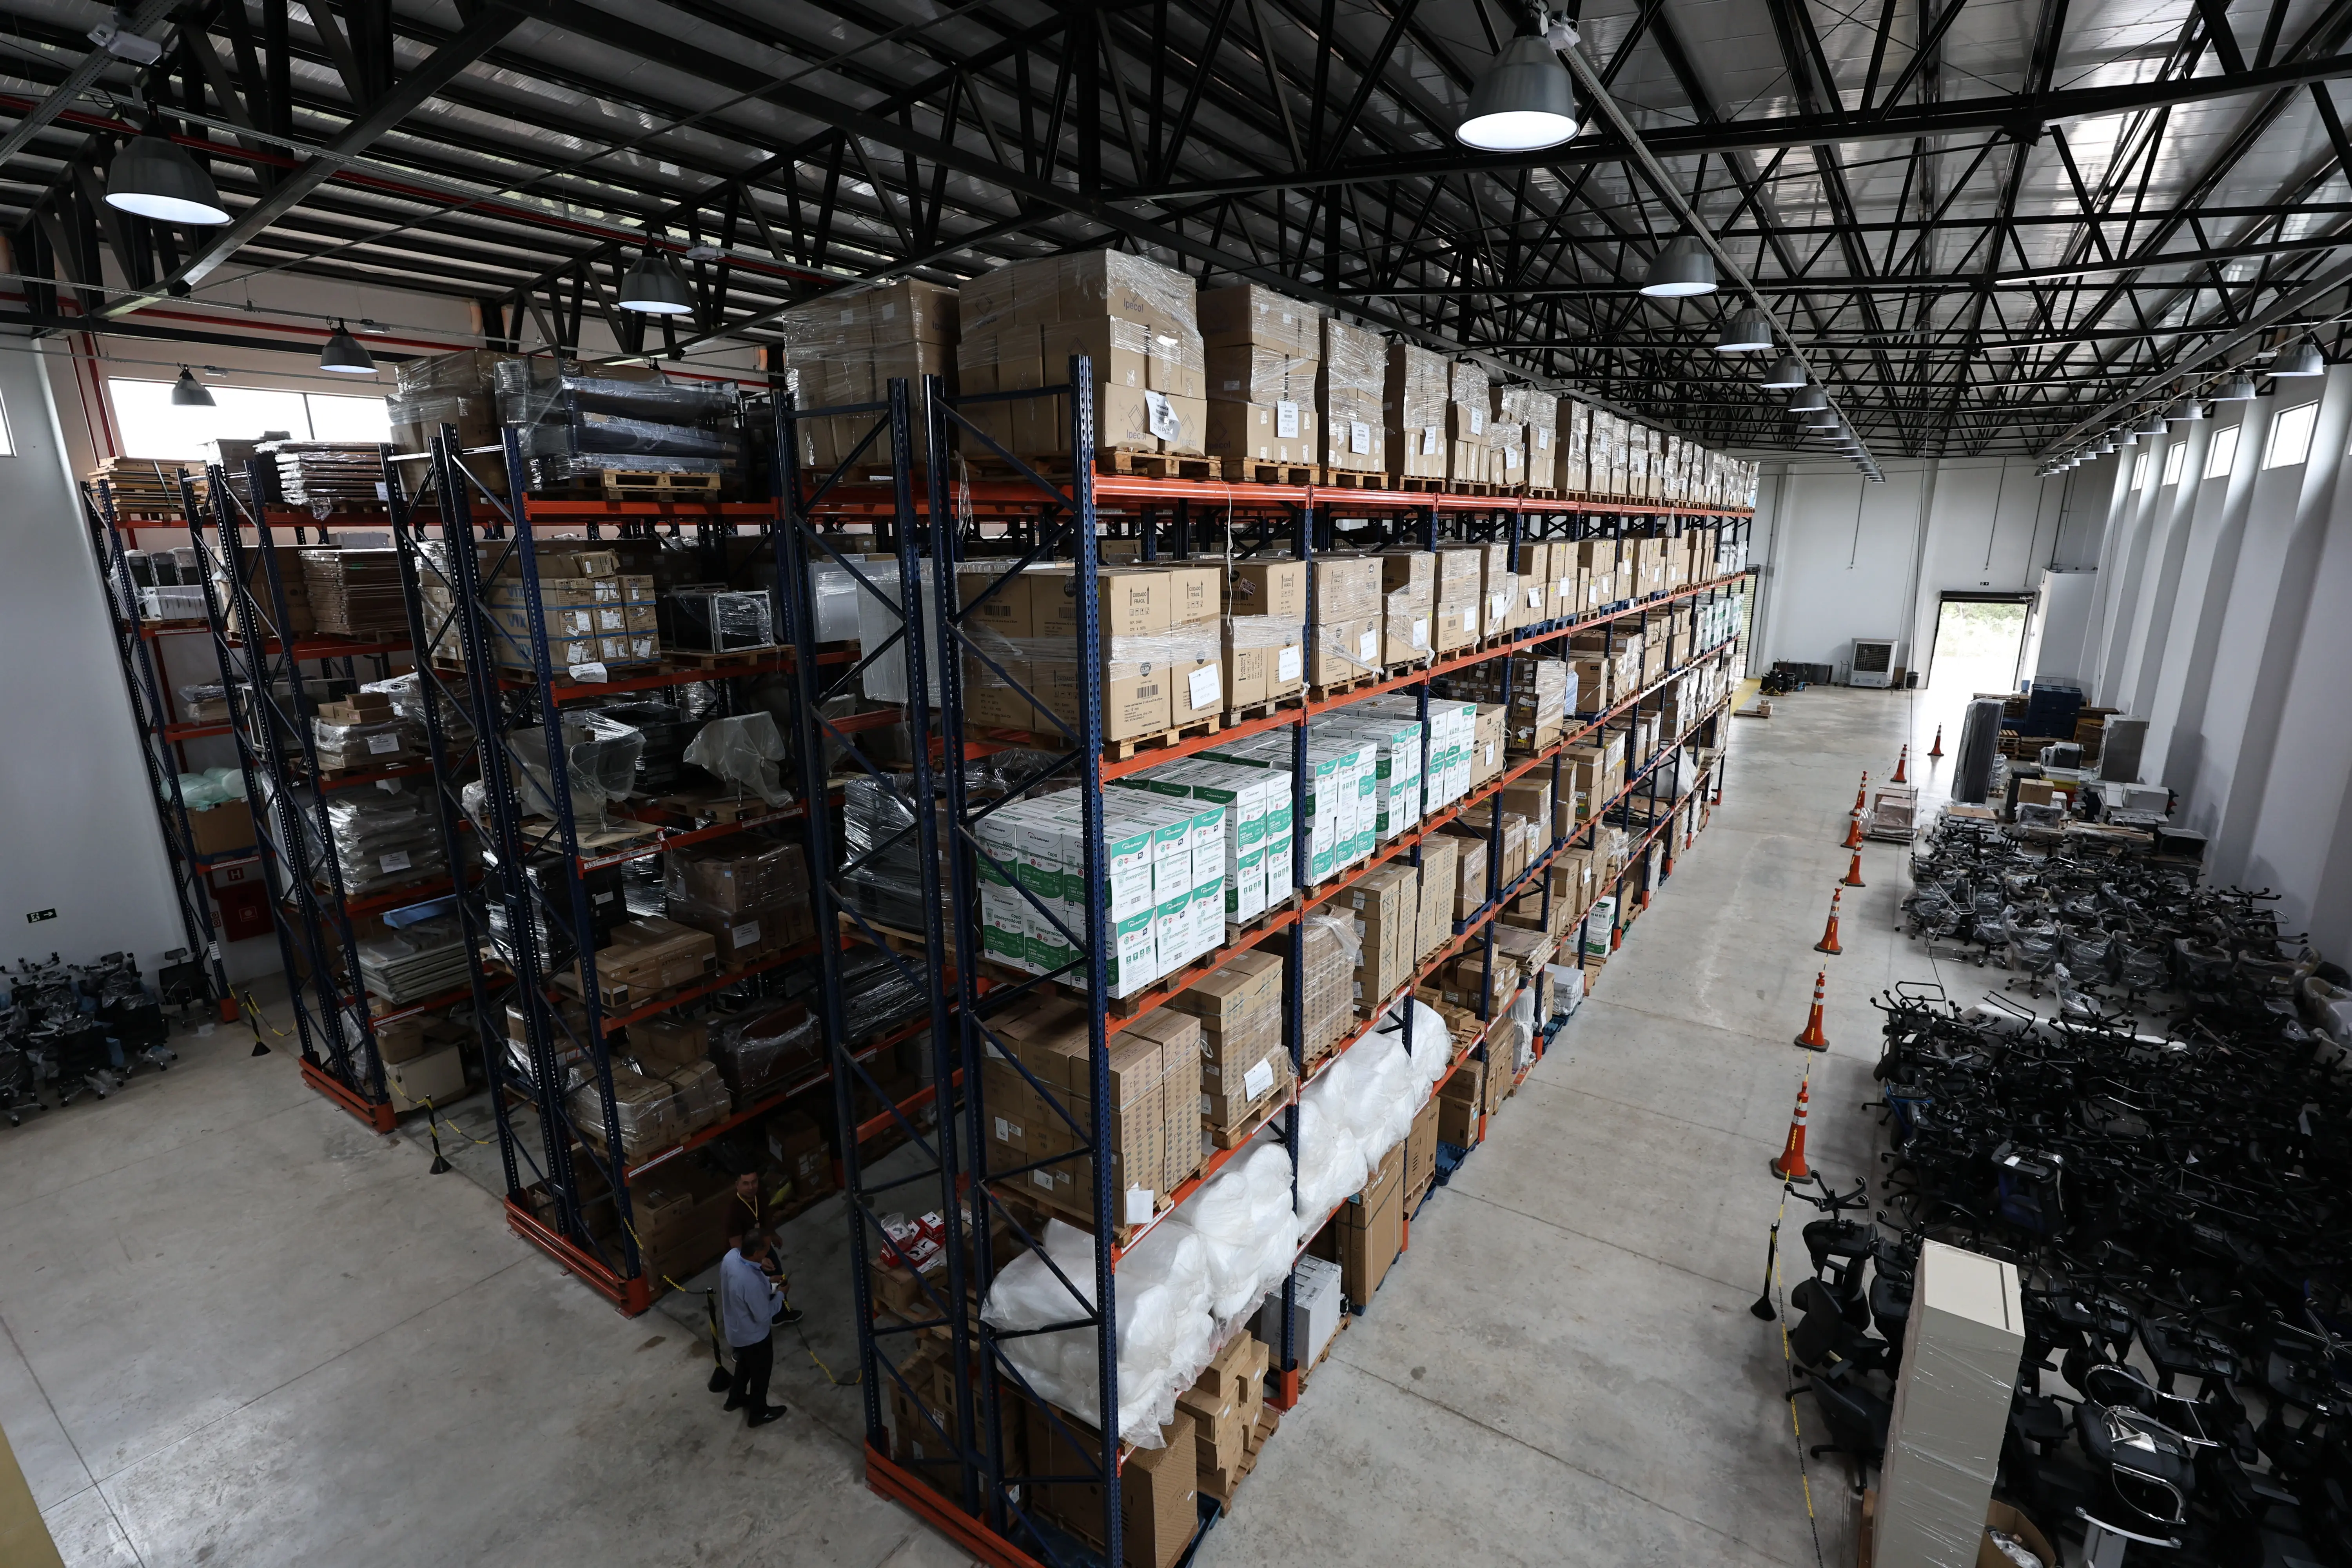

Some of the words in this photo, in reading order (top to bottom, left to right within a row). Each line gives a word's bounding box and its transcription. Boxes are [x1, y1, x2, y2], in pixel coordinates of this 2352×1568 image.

[1124, 298, 1143, 313] Ipecol
[1127, 429, 1147, 441] Ipecol
[1180, 437, 1196, 446] Ipecol
[1207, 441, 1230, 449] Ipecol
[506, 613, 526, 628] VIX
[986, 824, 1005, 833] Cristalcopo
[1165, 827, 1183, 836] Cristalcopo
[1123, 840, 1143, 850] Cristalcopo
[1203, 841, 1222, 852] Biodegradável
[1167, 855, 1188, 866] Biodegradável
[231, 870, 241, 880] H
[1125, 869, 1149, 882] Biodegradável
[1202, 884, 1217, 894] Cristalcopo
[1167, 900, 1184, 910] Cristalcopo
[994, 914, 1021, 925] Biodegradável
[1129, 916, 1147, 927] Cristalcopo
[1203, 910, 1222, 922] Biodegradável
[1036, 927, 1064, 938] Biodegradável
[1169, 926, 1189, 939] Biodegradável
